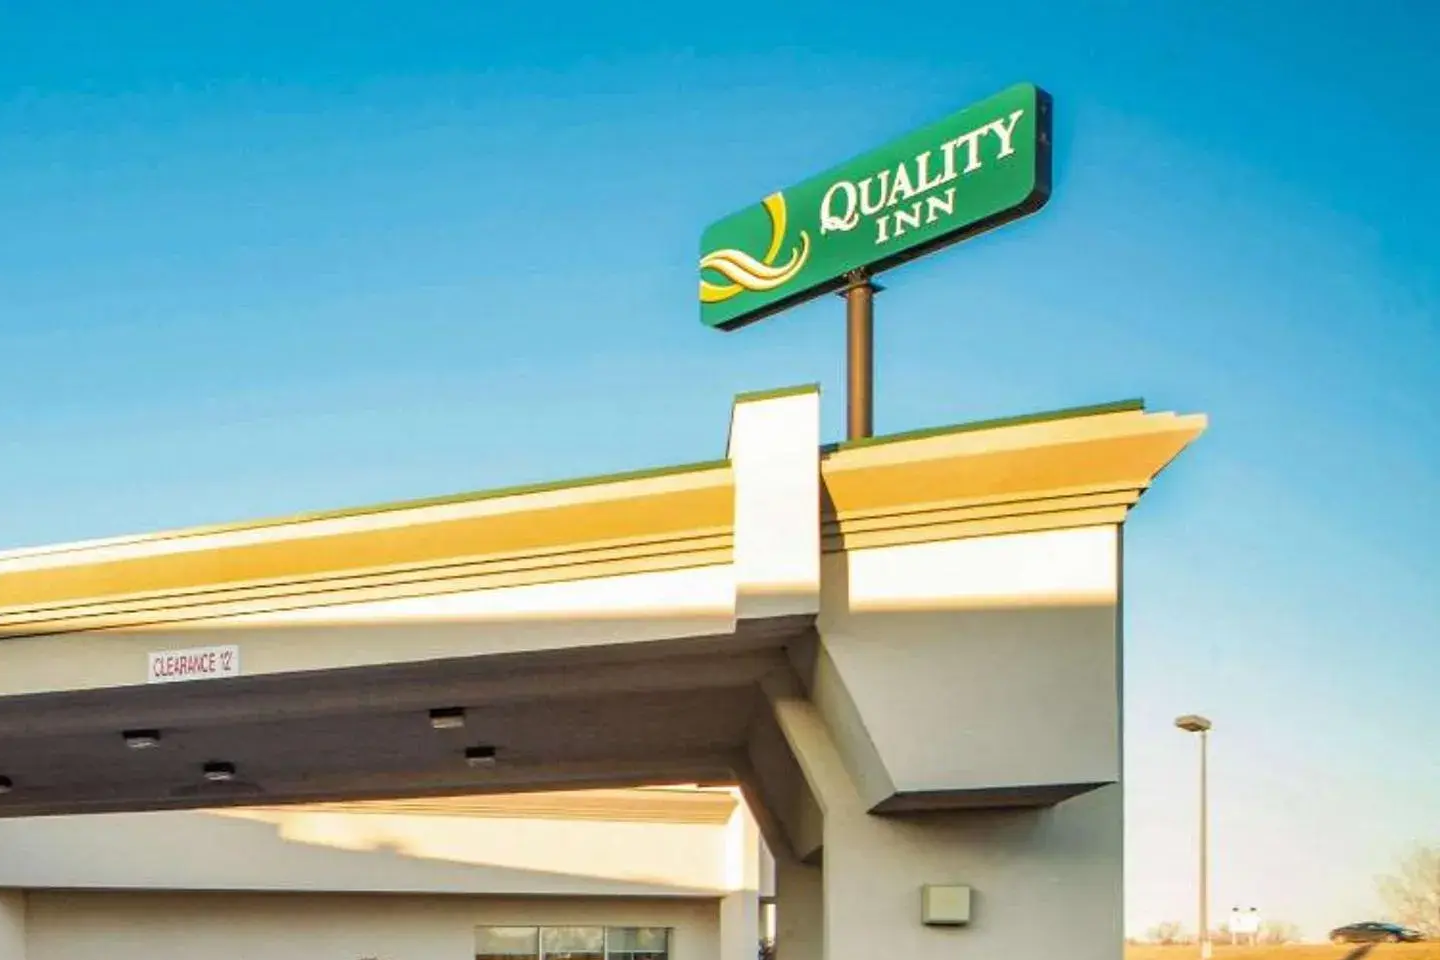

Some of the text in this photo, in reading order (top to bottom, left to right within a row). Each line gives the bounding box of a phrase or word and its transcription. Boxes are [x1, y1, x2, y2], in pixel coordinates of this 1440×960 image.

[821, 109, 1023, 236] QUALITY
[875, 188, 957, 244] INN
[153, 652, 216, 677] CLEARANCE
